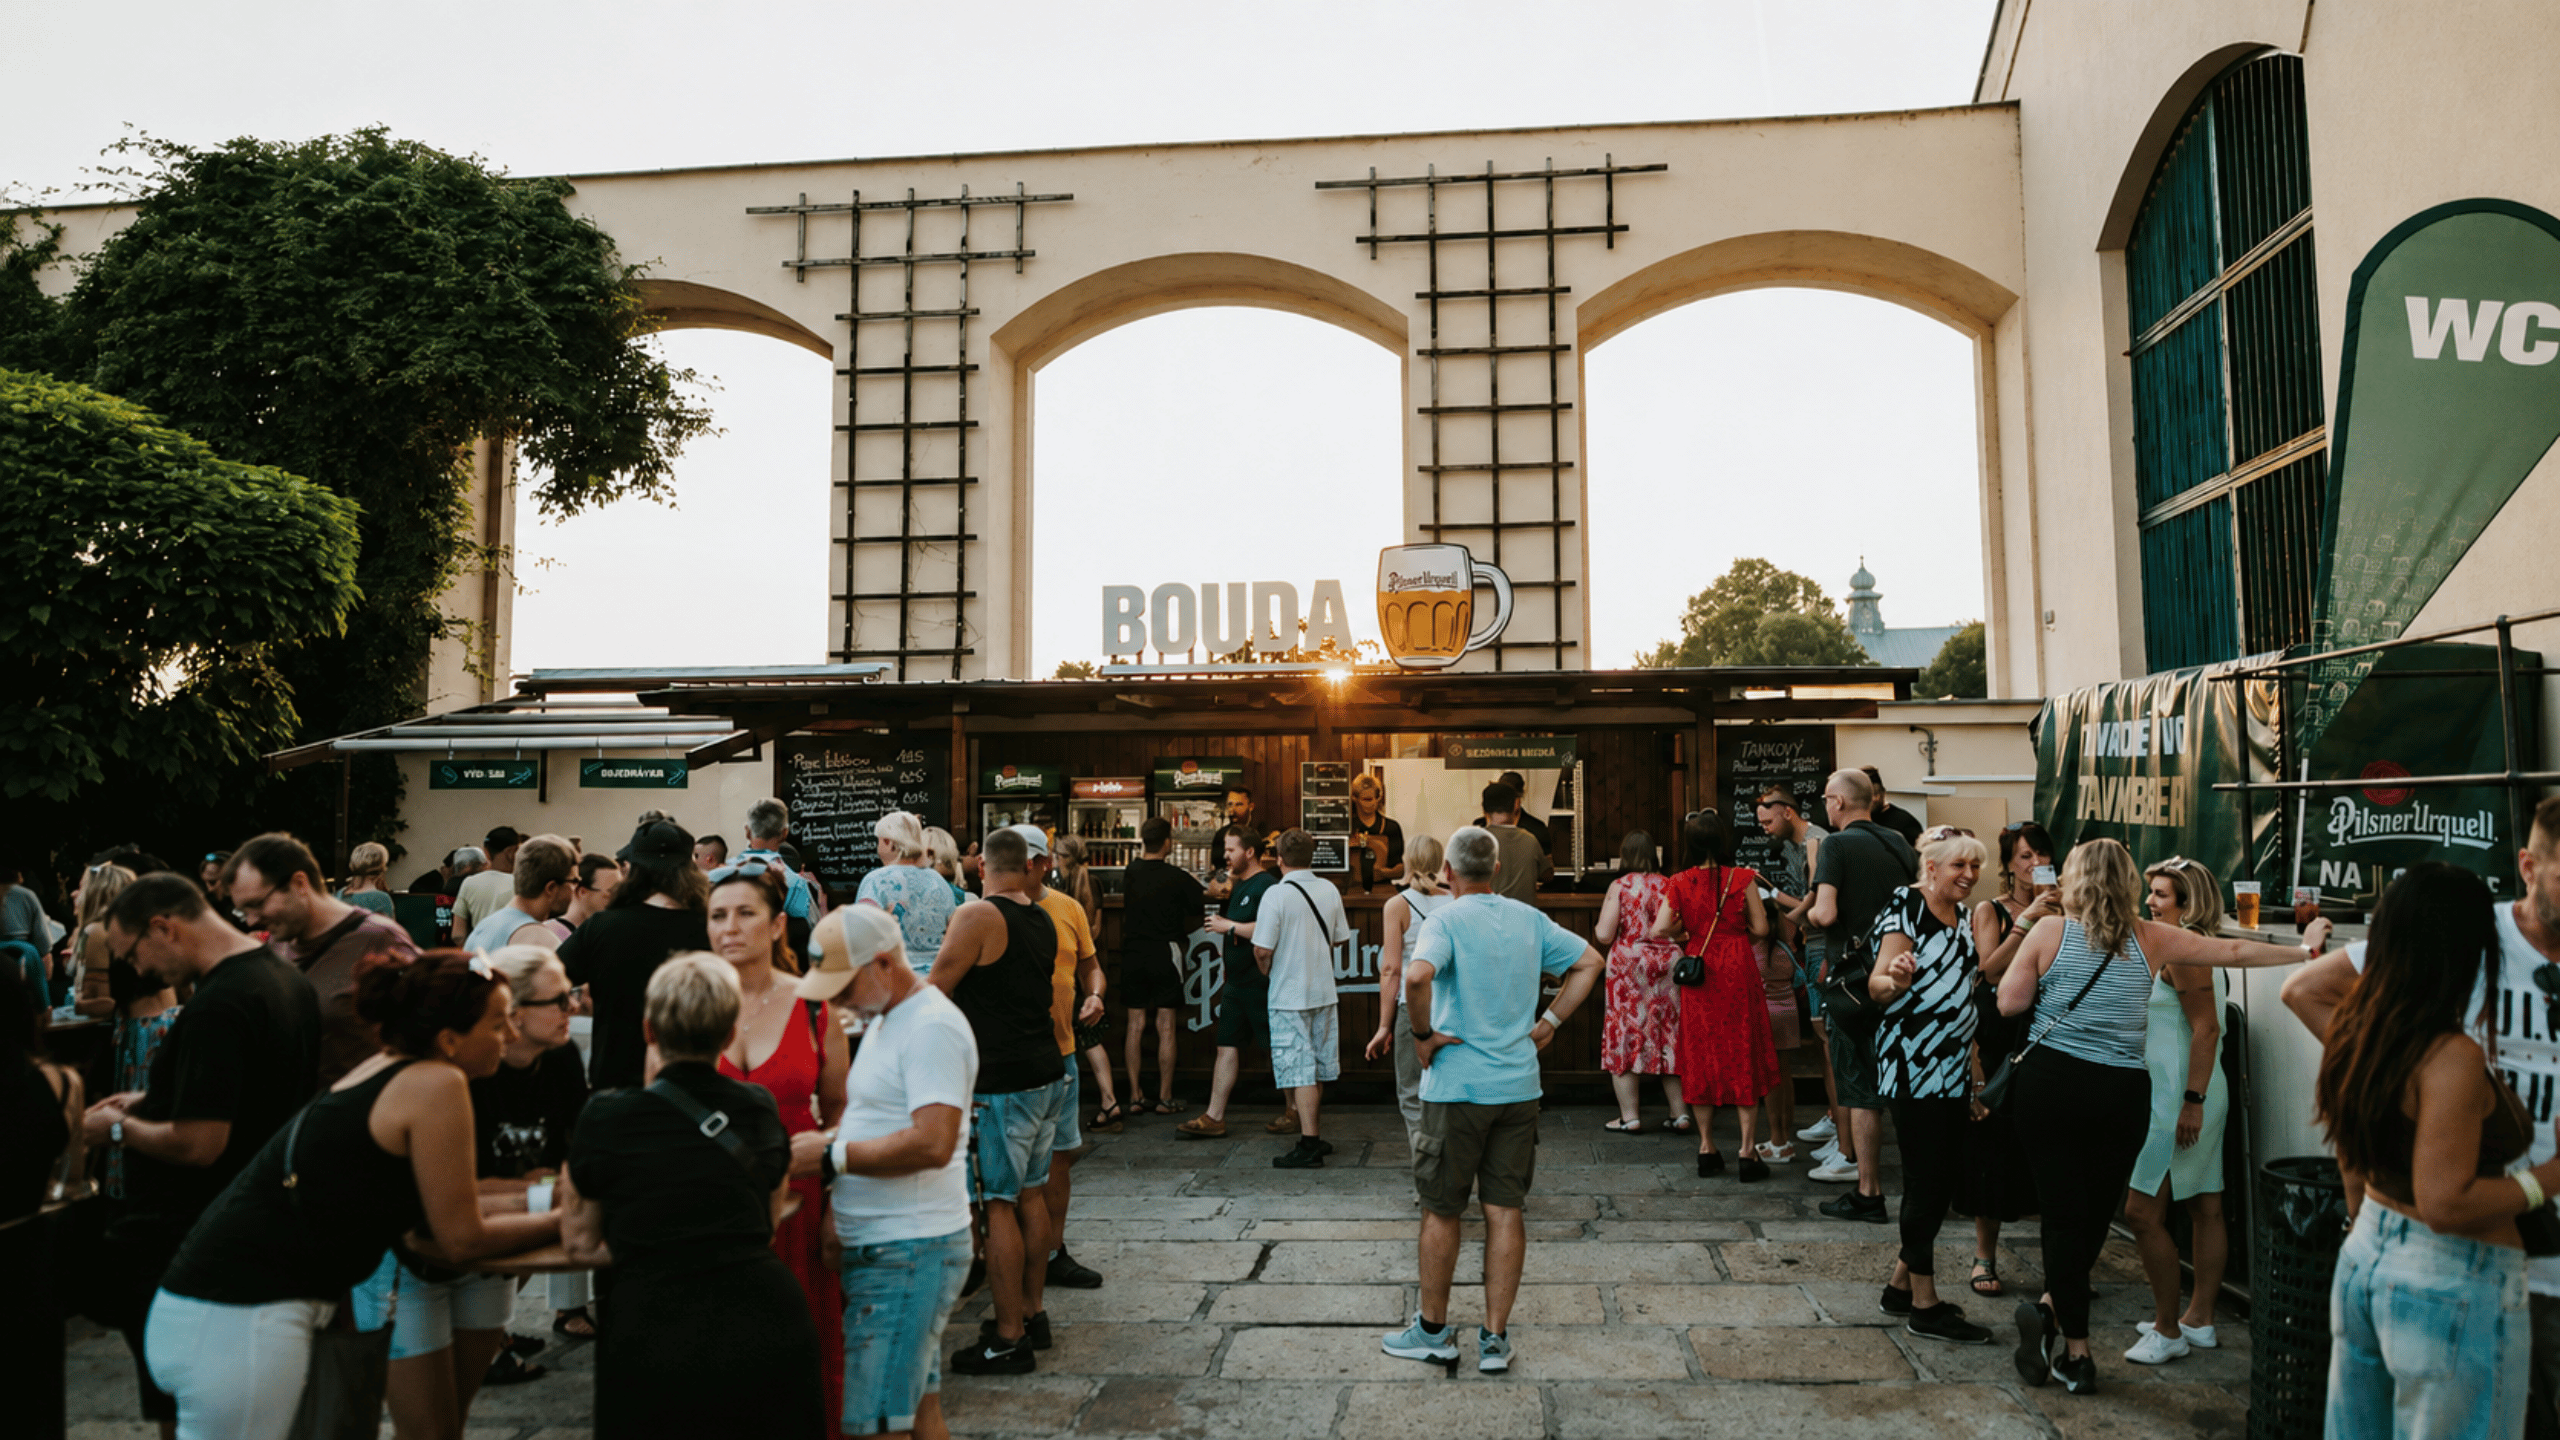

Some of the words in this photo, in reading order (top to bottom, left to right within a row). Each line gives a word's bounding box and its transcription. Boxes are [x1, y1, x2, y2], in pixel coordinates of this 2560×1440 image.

[2405, 296, 2560, 366] WC
[1102, 579, 1352, 656] BOUDA
[2327, 796, 2413, 847] Pilsner
[2412, 799, 2495, 848] Urquell
[2319, 859, 2363, 890] NA
